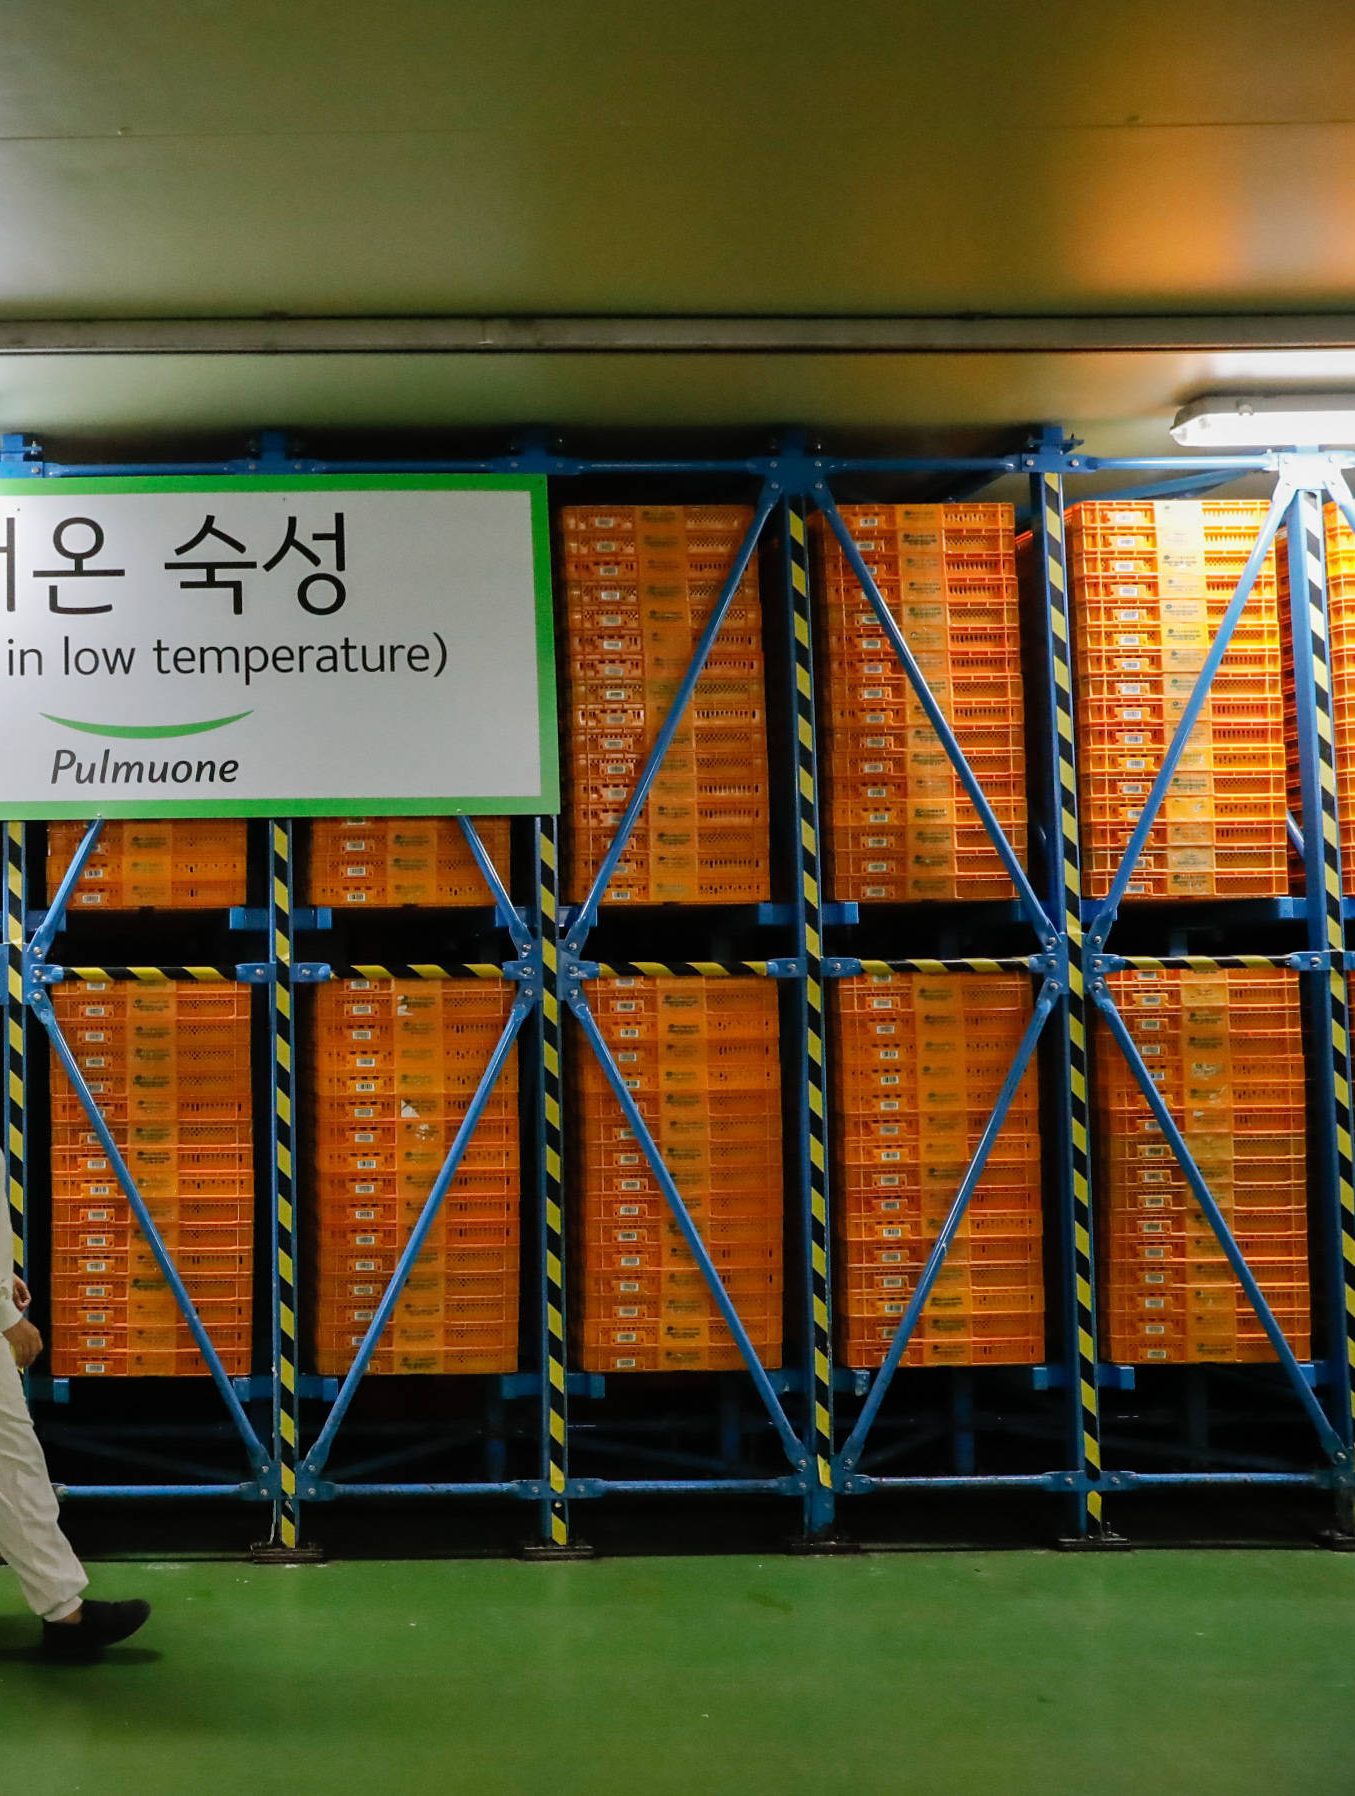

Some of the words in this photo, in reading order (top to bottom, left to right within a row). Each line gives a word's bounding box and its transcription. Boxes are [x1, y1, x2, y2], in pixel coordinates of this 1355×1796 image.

[164, 511, 347, 617] 숙성
[6, 637, 44, 677] in
[63, 635, 137, 677] low
[152, 631, 449, 688] temperature)
[50, 748, 241, 785] Pulmuone
